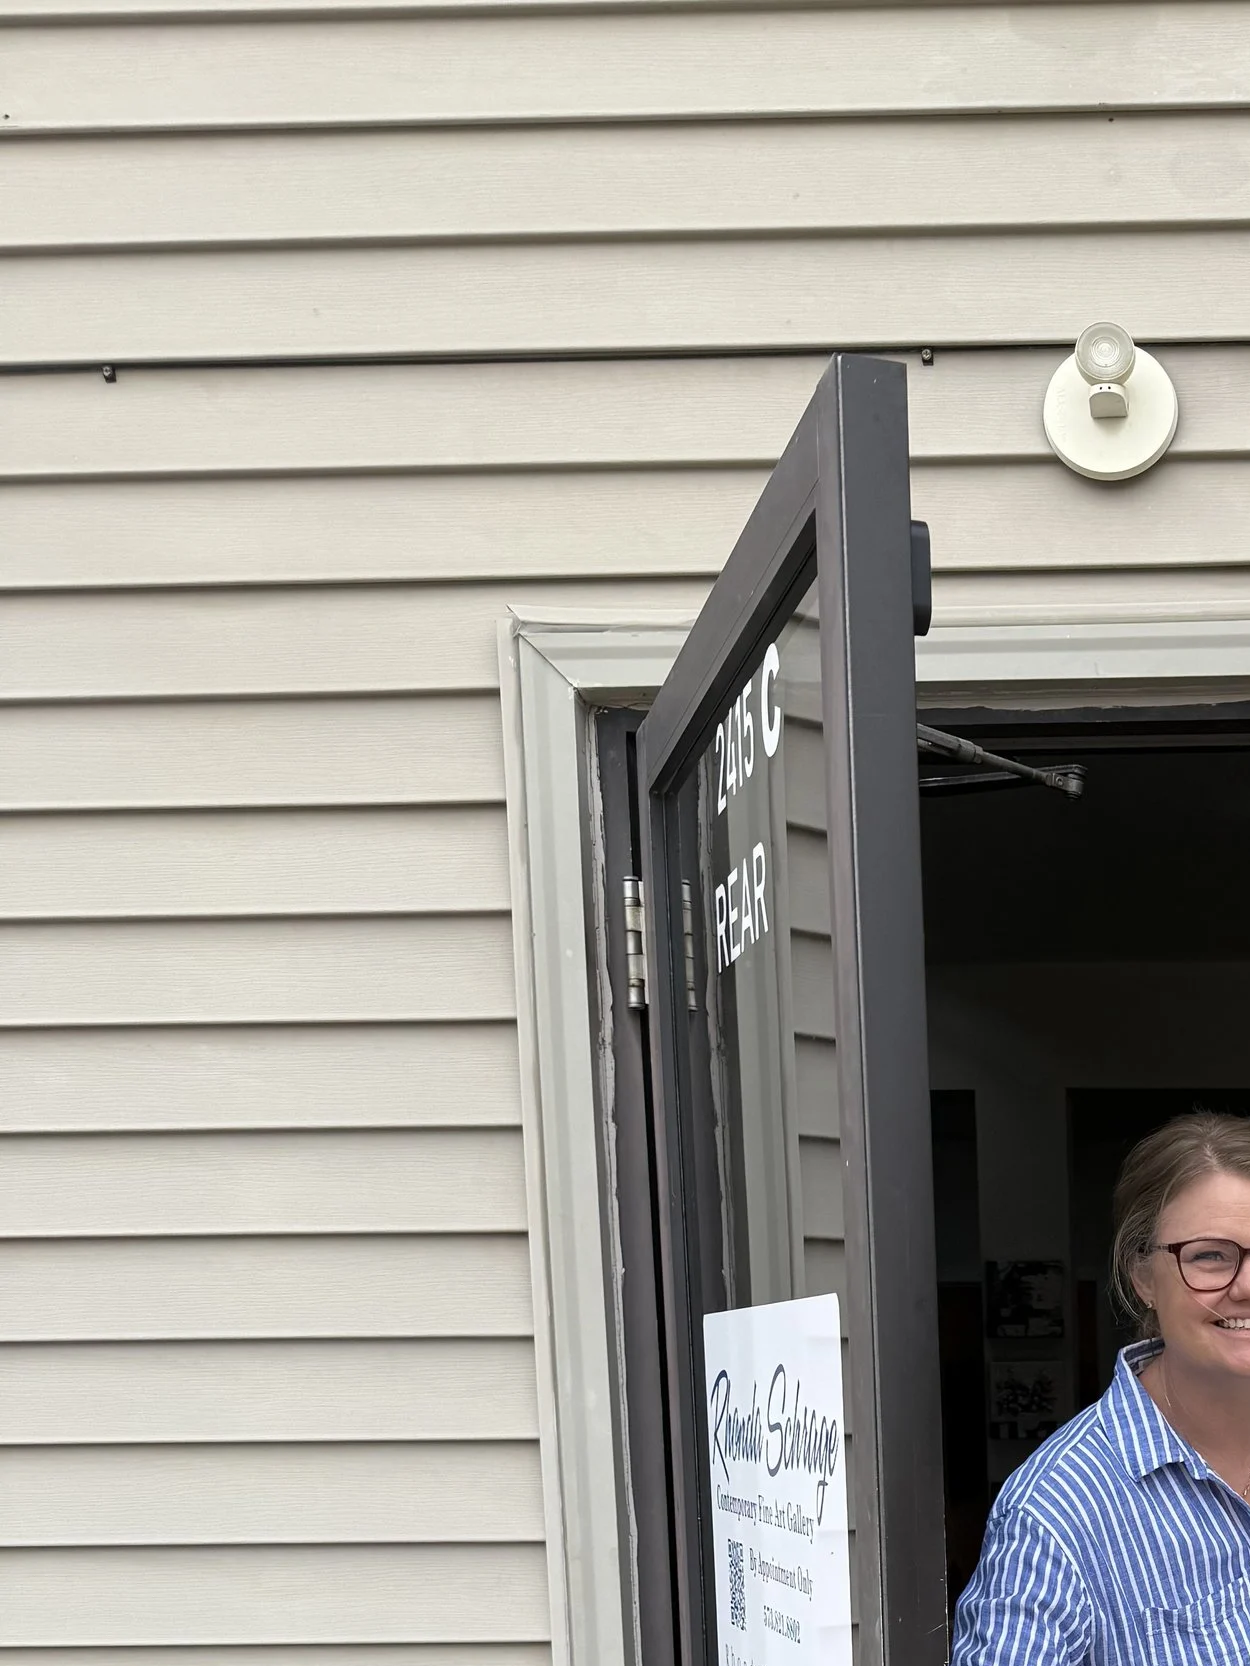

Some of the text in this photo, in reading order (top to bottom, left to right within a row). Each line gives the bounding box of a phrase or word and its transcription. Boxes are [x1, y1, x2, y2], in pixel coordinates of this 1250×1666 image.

[715, 642, 782, 816] 2415 C
[714, 841, 769, 974] REAR
[710, 1363, 840, 1526] Rhonda Schrage
[716, 1484, 815, 1545] Contemporary Fine Art Gallery
[749, 1547, 814, 1602] By Appointment Only
